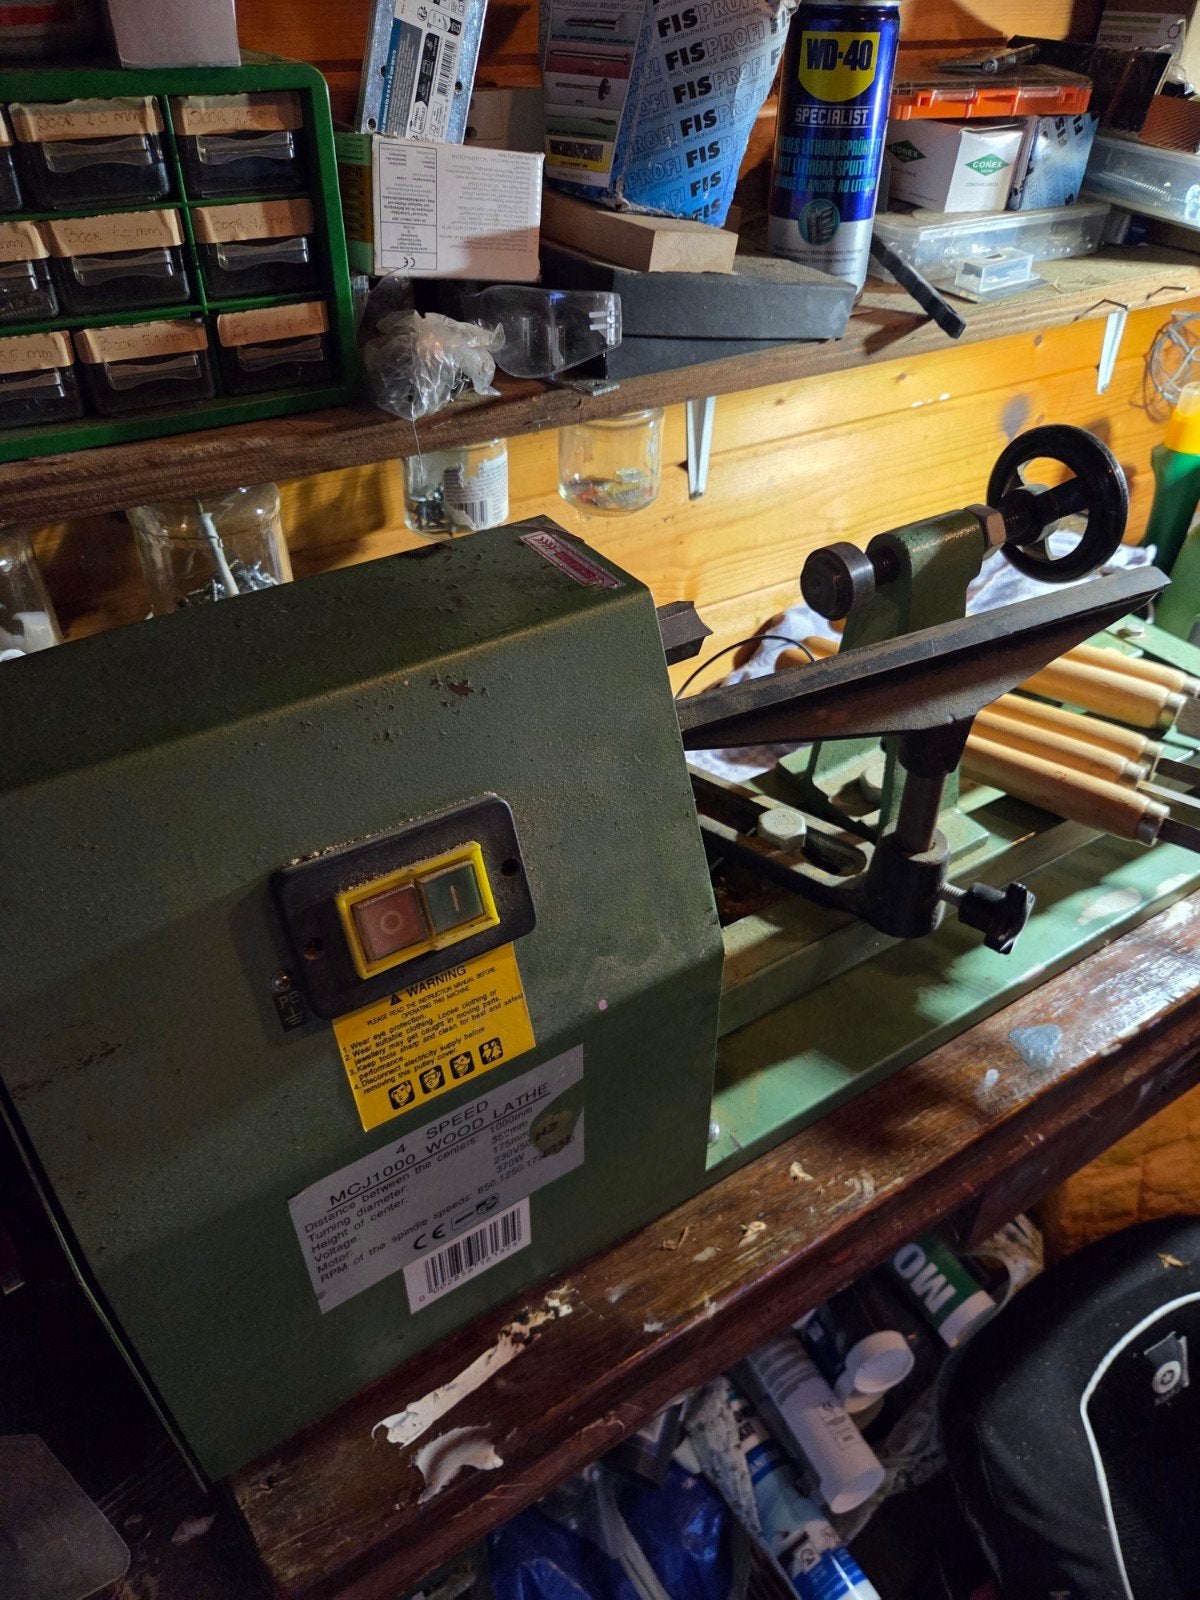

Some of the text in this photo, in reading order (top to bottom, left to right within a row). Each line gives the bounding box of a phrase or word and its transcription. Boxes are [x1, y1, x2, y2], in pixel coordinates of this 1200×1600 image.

[807, 38, 873, 71] WD-40
[795, 107, 869, 126] SPECIALIST
[838, 178, 850, 193] AU
[972, 161, 1003, 169] CONEX
[279, 990, 300, 1009] PE
[367, 966, 497, 1026] PLEASE READ THE INSTRUCTION MANUAL BEFORE
[406, 965, 467, 997] WARNING
[433, 996, 445, 1005] THIS
[350, 1038, 370, 1050] Wear
[373, 1031, 386, 1041] eye
[389, 1014, 426, 1034] protection.
[352, 1045, 372, 1057] Wear
[375, 1031, 403, 1047] suitable
[437, 1006, 459, 1019] Loose
[461, 994, 488, 1009] clothing
[354, 1047, 386, 1066] jewellery
[388, 1039, 404, 1050] may
[406, 1033, 419, 1043] get
[421, 1020, 445, 1035] caught
[456, 1005, 480, 1019] moving
[482, 997, 501, 1009] parts.
[357, 1060, 377, 1073] Keep
[379, 1051, 397, 1062] tools
[400, 1041, 420, 1053] sharp
[422, 1033, 436, 1043] and
[438, 1023, 458, 1035] clean
[471, 1009, 486, 1020] best
[488, 1003, 502, 1013] and
[503, 992, 524, 1005] safest
[361, 1064, 401, 1087] Disconnect
[404, 1049, 437, 1068] electricity
[440, 1037, 461, 1051] supply
[463, 1026, 486, 1039] before
[363, 1076, 396, 1094] removing
[398, 1068, 411, 1078] this
[413, 1058, 435, 1072] pulley
[329, 1082, 548, 1206] MCJ1000 WOOD LATHE
[396, 1100, 489, 1154] 4 SPEED
[304, 1107, 533, 1233] Distance between the centers: 1000mm
[311, 1130, 530, 1254] Height of center: 175mm
[307, 1217, 351, 1244] Turning
[357, 1185, 408, 1217] diameter:
[317, 1153, 525, 1274] Motor: 370W
[321, 1263, 349, 1283] RPM
[353, 1254, 365, 1265] of
[368, 1242, 387, 1256] the
[391, 1219, 429, 1242] spindle
[433, 1193, 473, 1219] speeds:
[414, 1223, 446, 1250] CE
[314, 1235, 361, 1264] Voltage:
